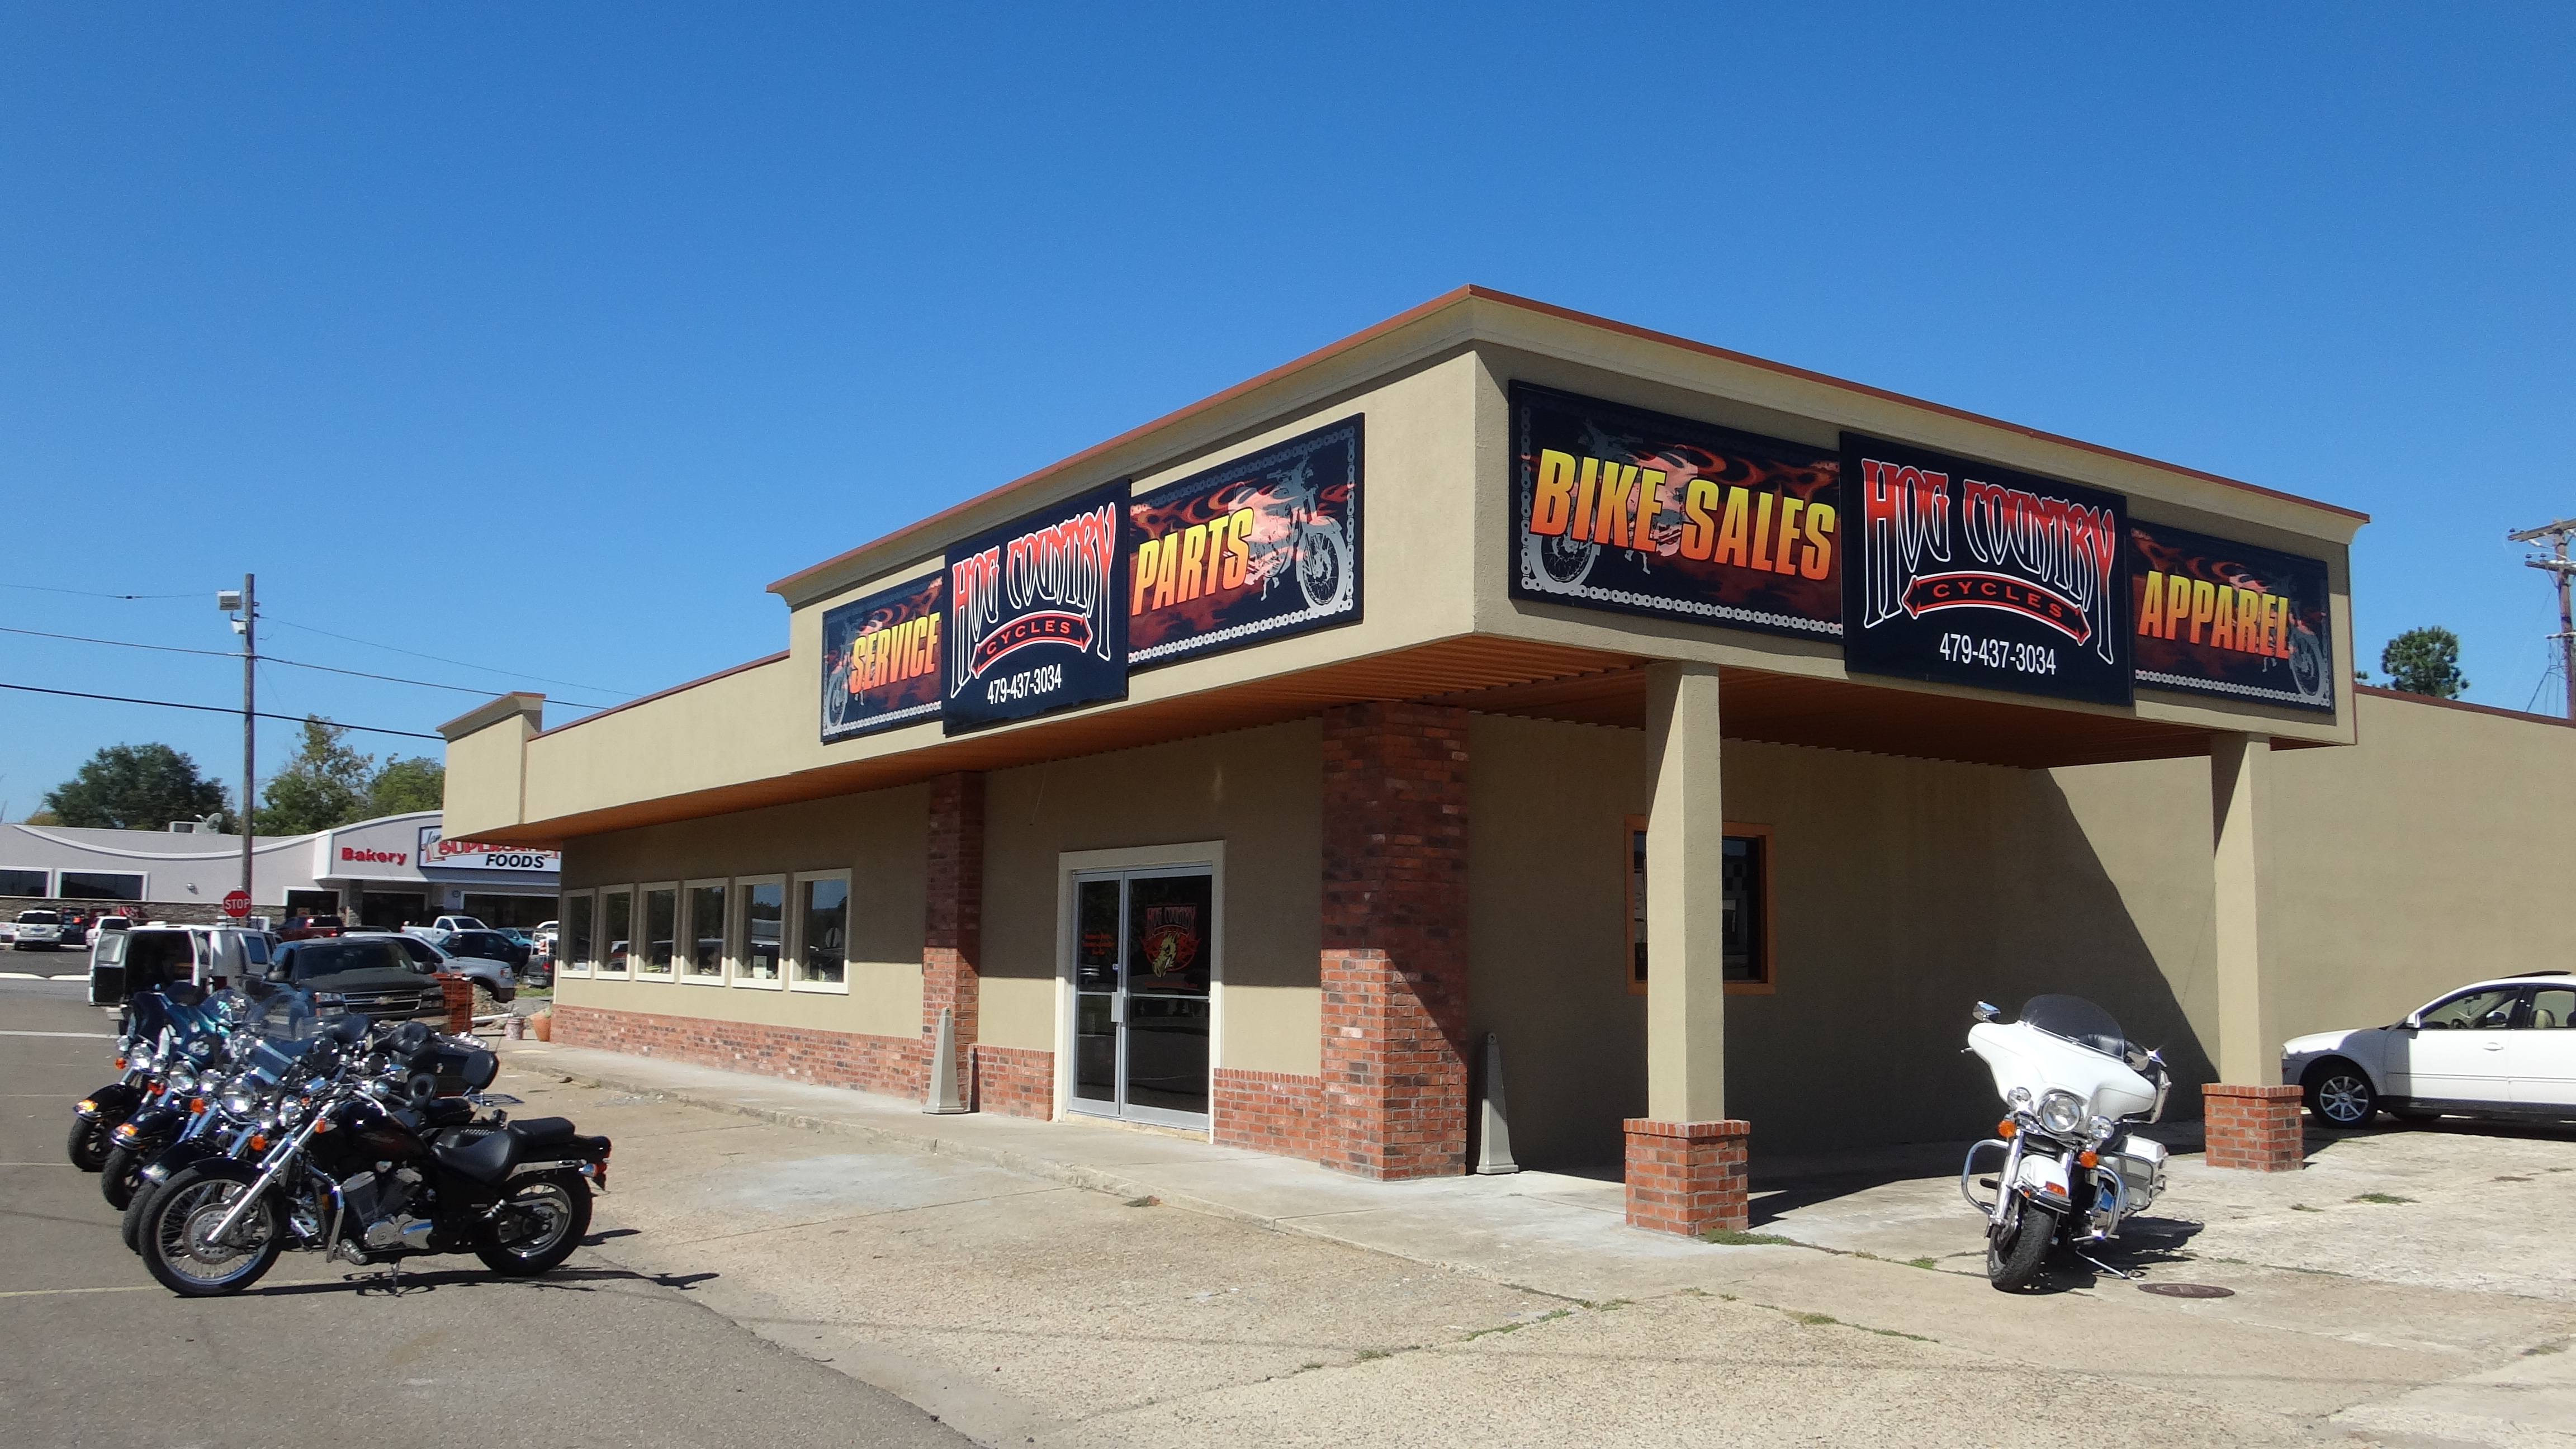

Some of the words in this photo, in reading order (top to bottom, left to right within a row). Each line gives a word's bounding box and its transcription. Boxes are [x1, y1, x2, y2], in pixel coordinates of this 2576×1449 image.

[1530, 448, 1667, 553] BIKE
[1679, 479, 1835, 581] SALES
[1131, 507, 1254, 616] PARTS
[1861, 458, 1951, 629] HOG
[1963, 479, 2116, 665] COUNTRY
[950, 545, 1000, 699] HOG
[1006, 501, 1116, 661] COUNTRY
[1932, 581, 2063, 618] CYCLES
[2137, 570, 2290, 659] APPAREL
[849, 612, 941, 694] SERVICE
[986, 619, 1071, 656] CYCLES
[1939, 632, 2057, 675] 479-437-3034
[987, 663, 1062, 705] 479-437-3034
[342, 847, 407, 866] Bakery
[486, 854, 545, 868] FOODS
[225, 898, 250, 910] STOP
